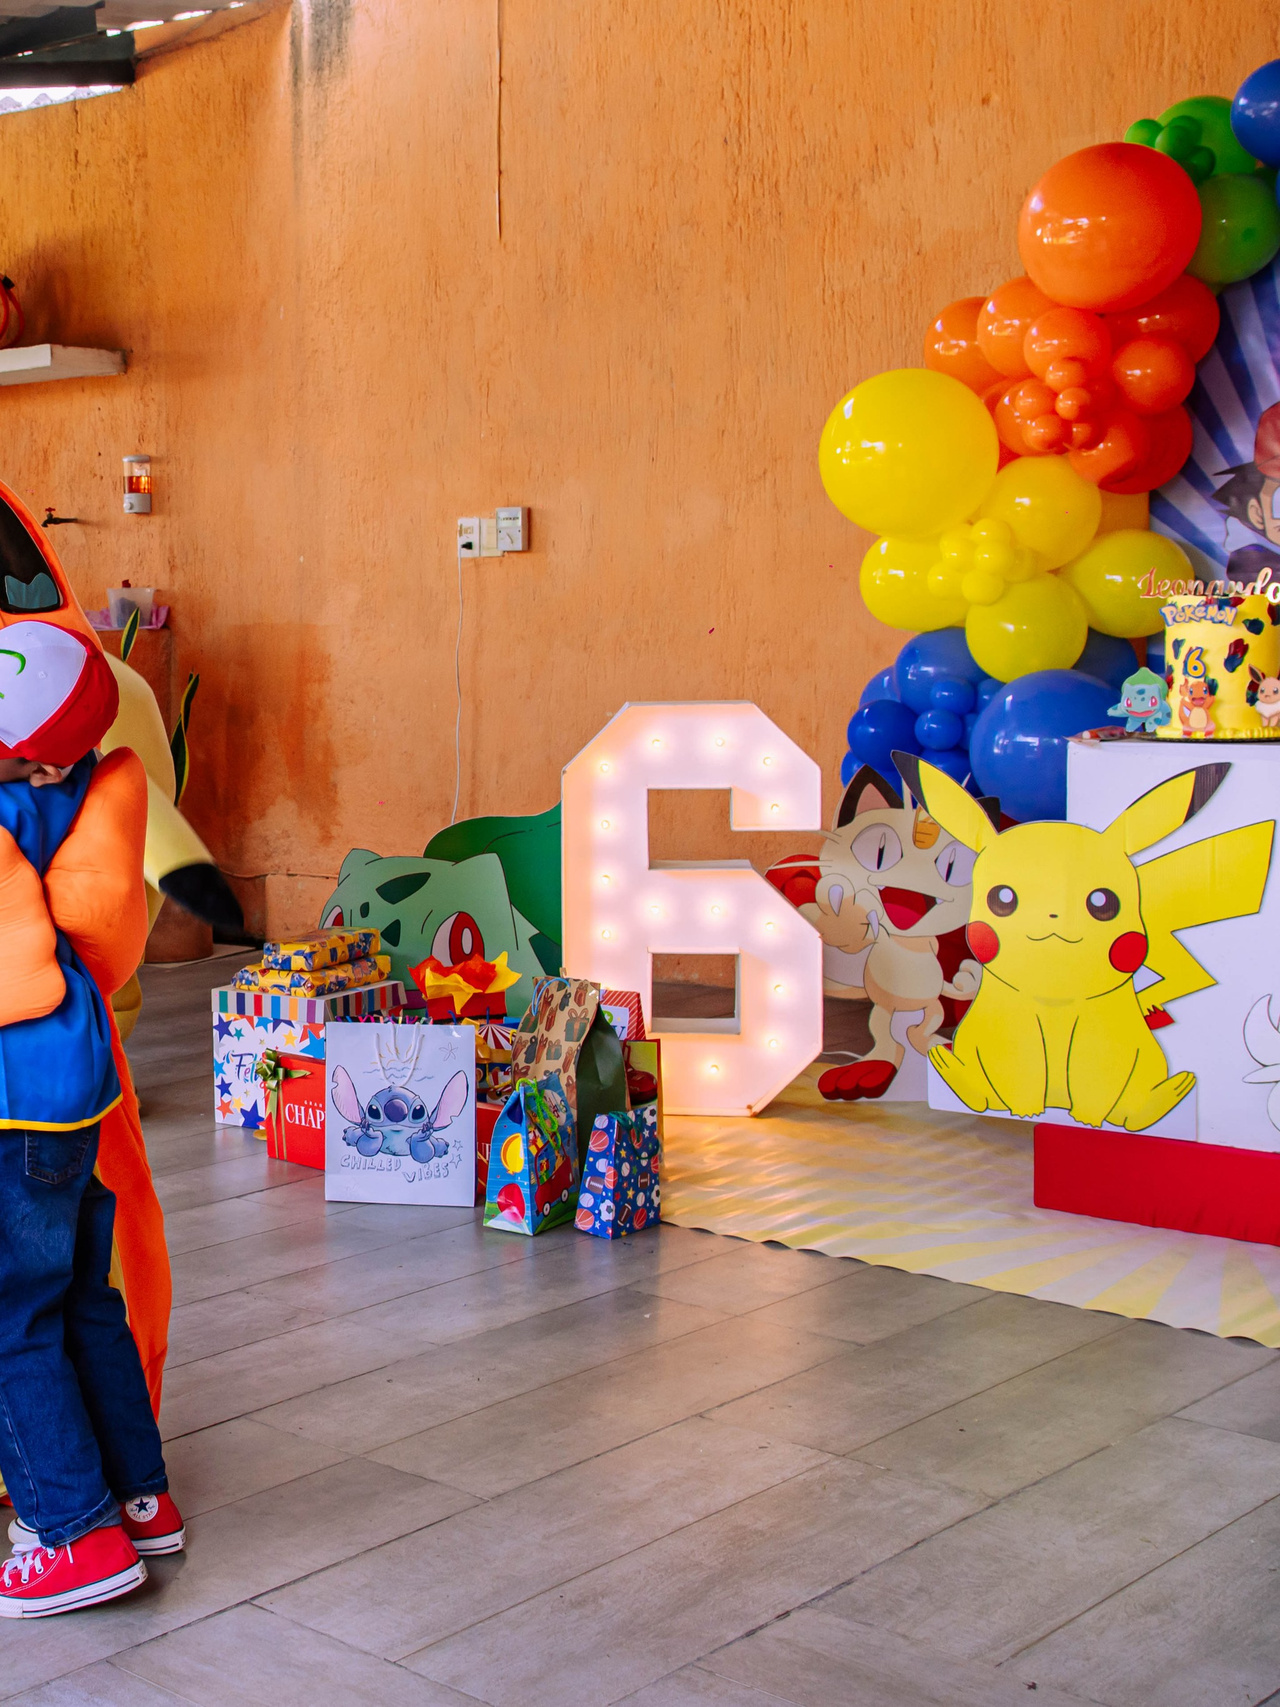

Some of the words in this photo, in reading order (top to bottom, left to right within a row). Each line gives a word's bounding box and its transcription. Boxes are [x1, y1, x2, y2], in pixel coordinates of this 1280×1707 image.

[1187, 647, 1206, 678] 6
[562, 702, 823, 1117] 6
[285, 1102, 326, 1130] CHAP
[340, 1154, 402, 1172] CHILLED
[402, 1163, 450, 1183] VIBES
